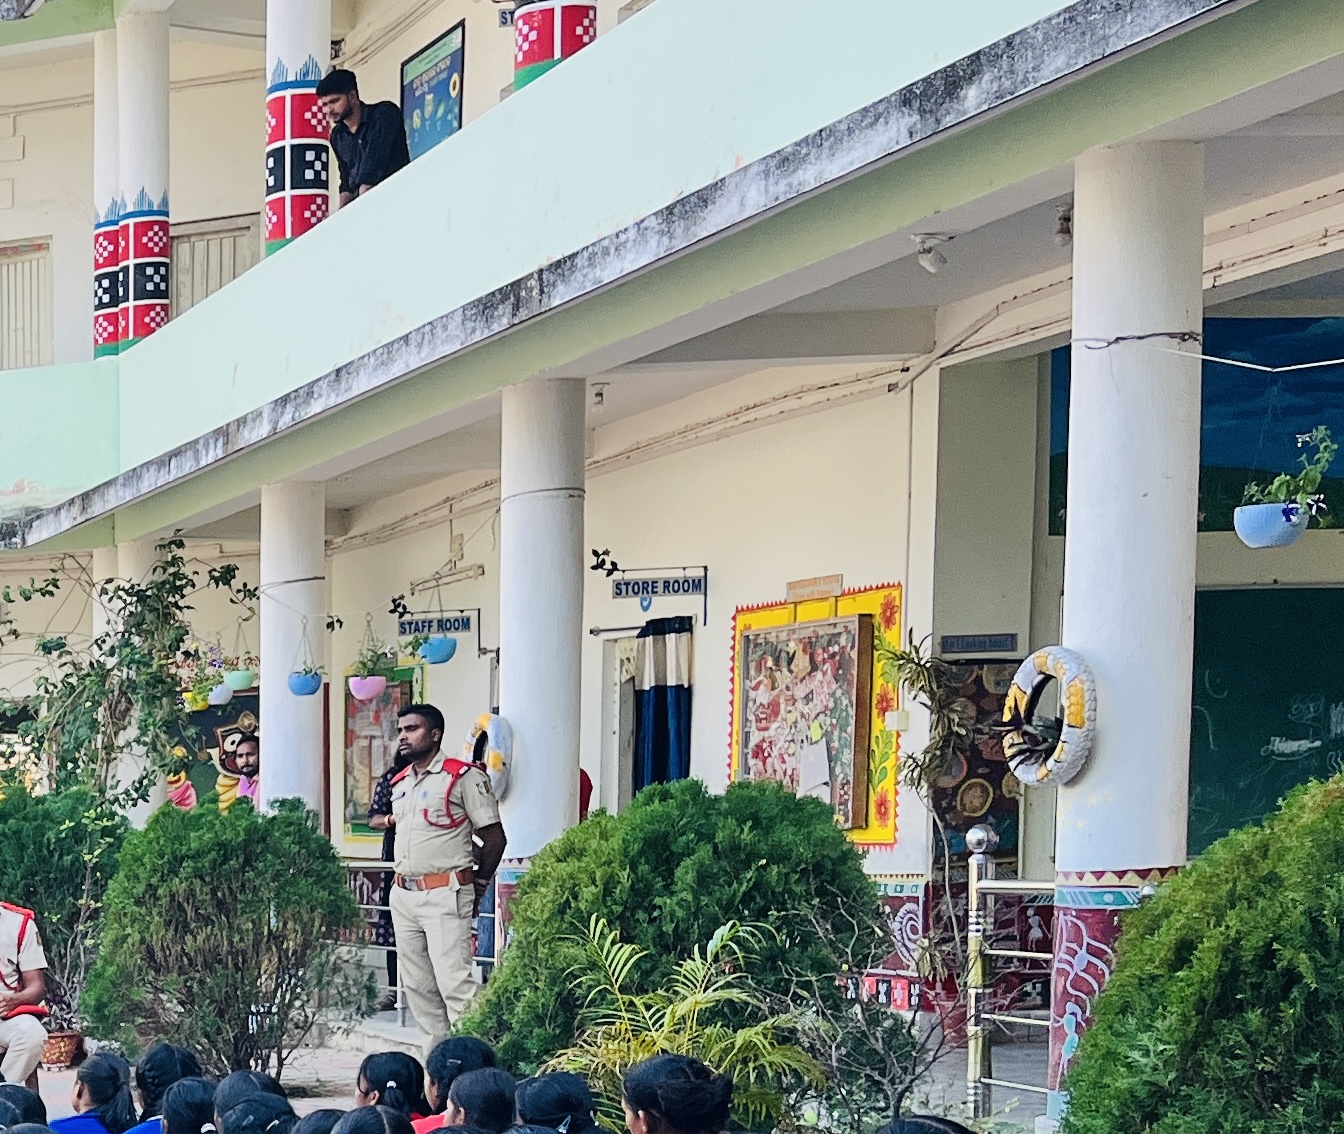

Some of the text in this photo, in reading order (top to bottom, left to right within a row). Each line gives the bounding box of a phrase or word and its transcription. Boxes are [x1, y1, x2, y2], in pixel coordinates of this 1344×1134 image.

[615, 578, 702, 596] STORE ROOM
[399, 616, 471, 634] STAFF ROOM
